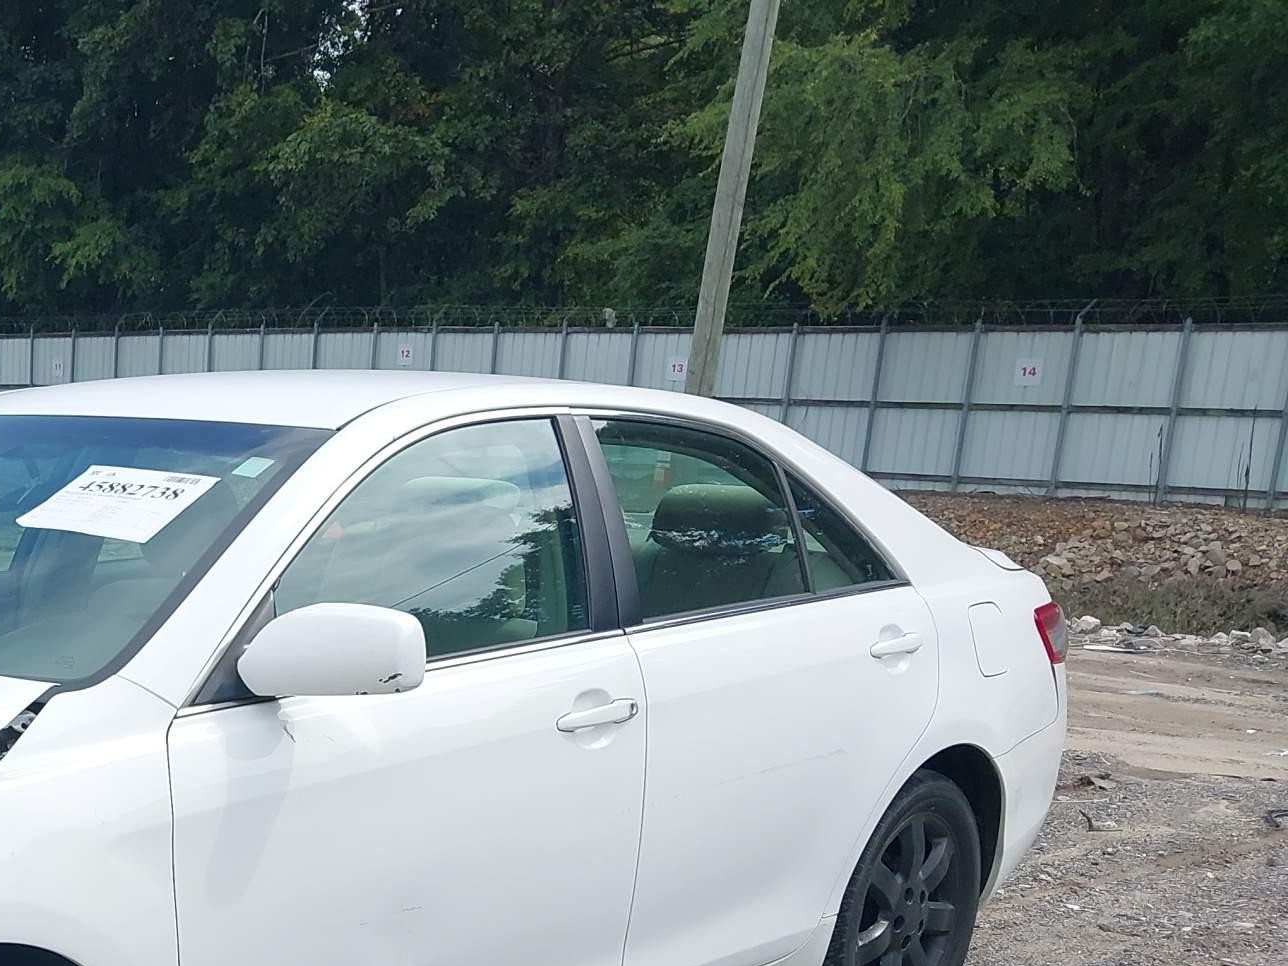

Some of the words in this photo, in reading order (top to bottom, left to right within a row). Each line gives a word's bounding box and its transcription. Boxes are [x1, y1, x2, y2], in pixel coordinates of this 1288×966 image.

[400, 349, 410, 359] 12
[671, 363, 684, 373] 13
[1021, 366, 1037, 377] 14
[78, 479, 185, 502] 45882738
